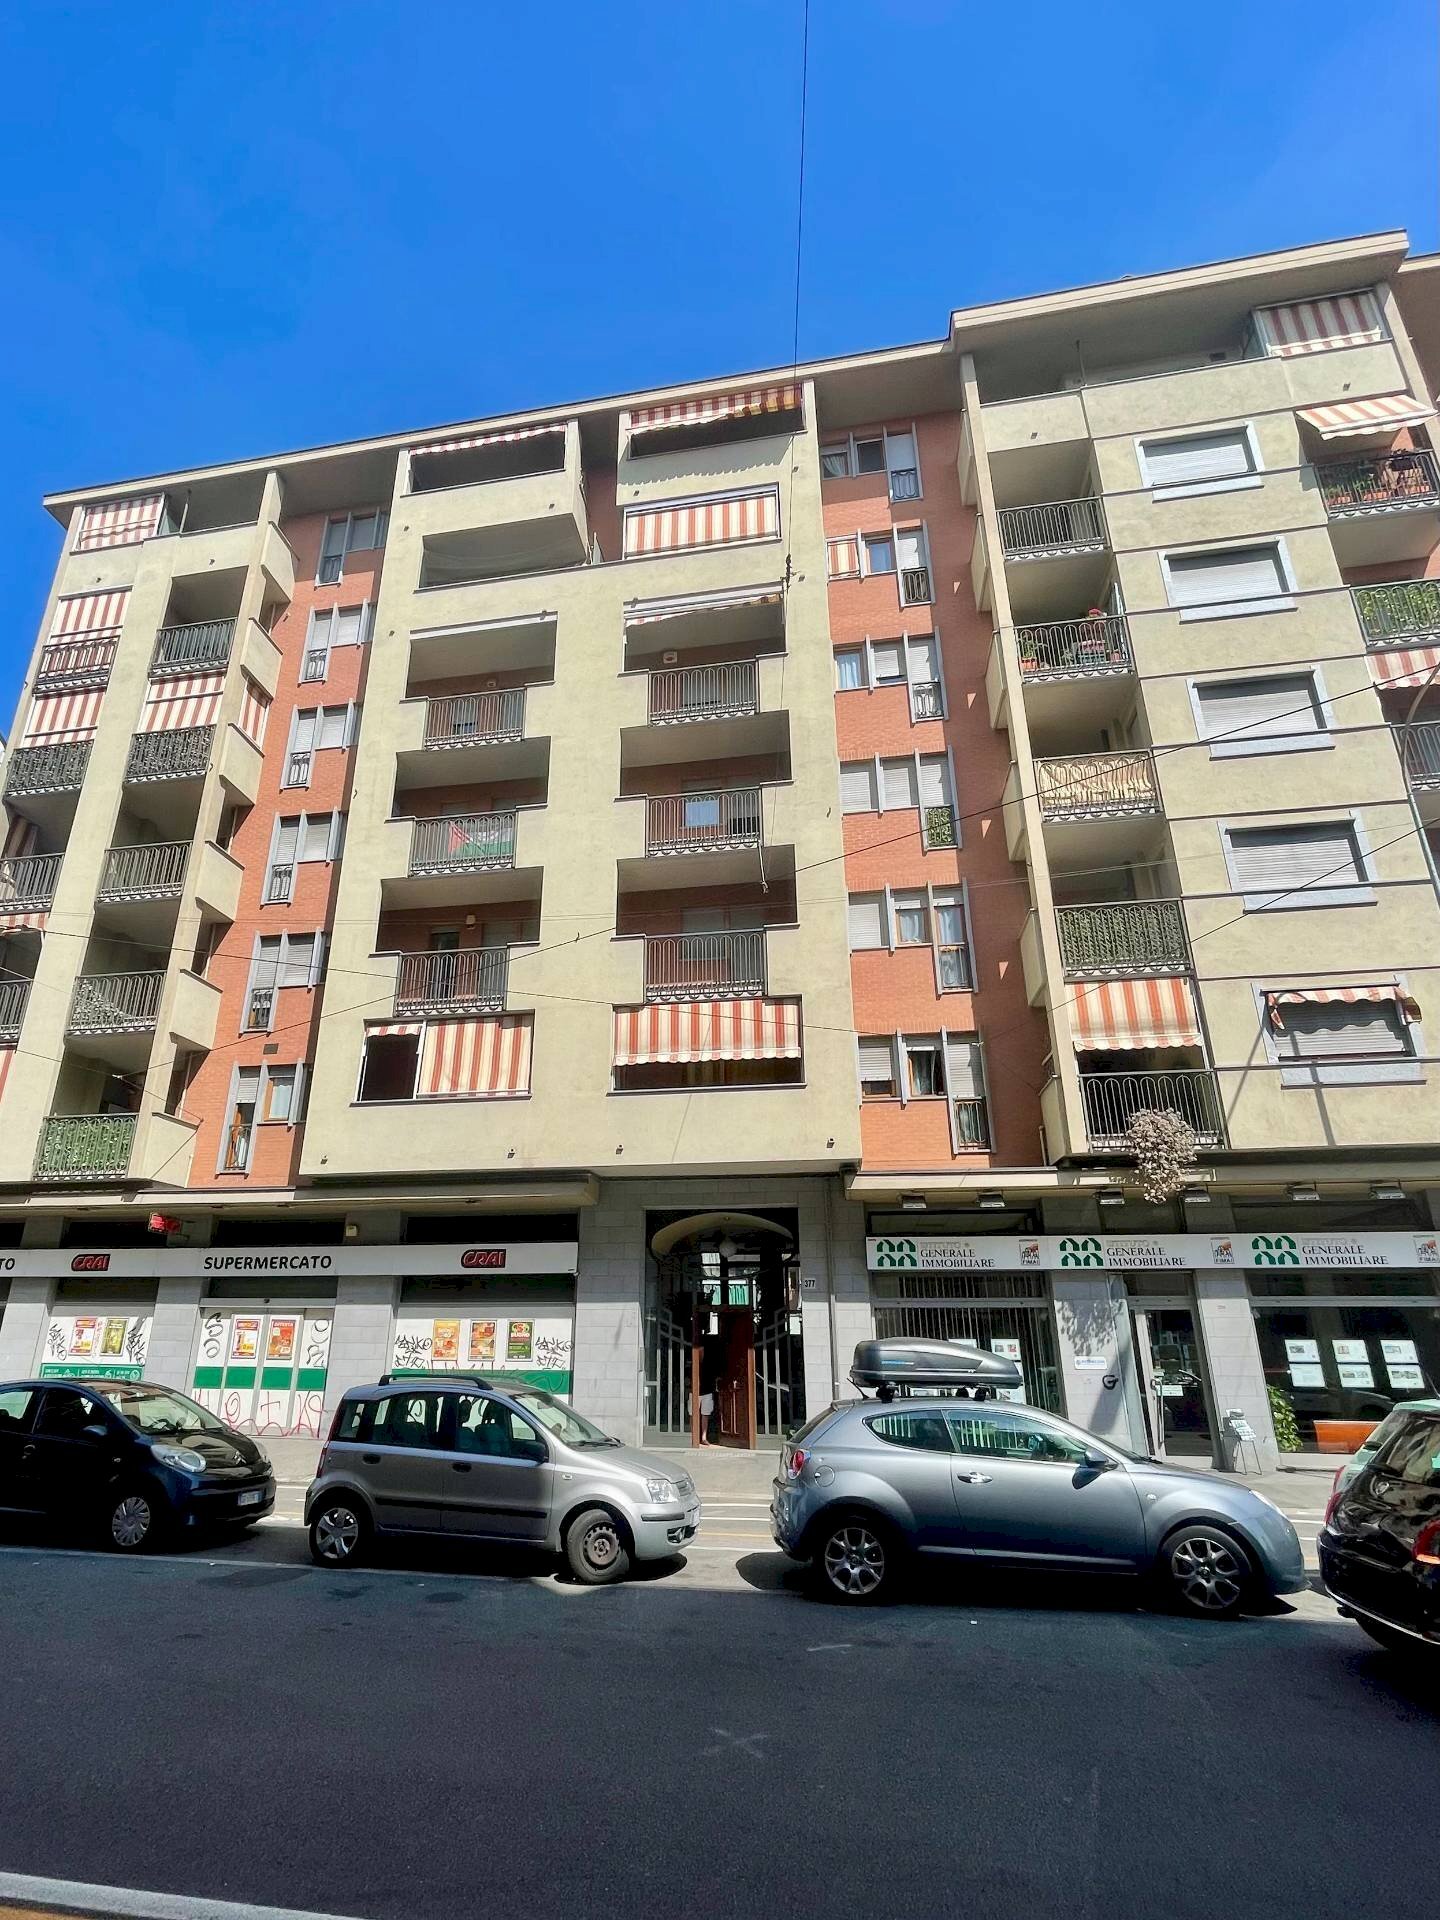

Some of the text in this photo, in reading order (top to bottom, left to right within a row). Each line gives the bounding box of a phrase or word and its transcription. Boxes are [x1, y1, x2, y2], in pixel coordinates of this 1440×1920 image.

[920, 1249, 976, 1258] GENERALE
[1106, 1247, 1166, 1256] GENERALE
[1302, 1245, 1366, 1255] GENERALE
[72, 1255, 110, 1270] CRAI
[203, 1255, 332, 1270] SUPERMERCATO
[463, 1251, 505, 1266] CRAI
[921, 1258, 995, 1268] IMMOBILIARE
[1108, 1257, 1187, 1267] IMMOBILIARE
[1305, 1255, 1389, 1265] IMMOBILIARE
[805, 1279, 816, 1288] 377
